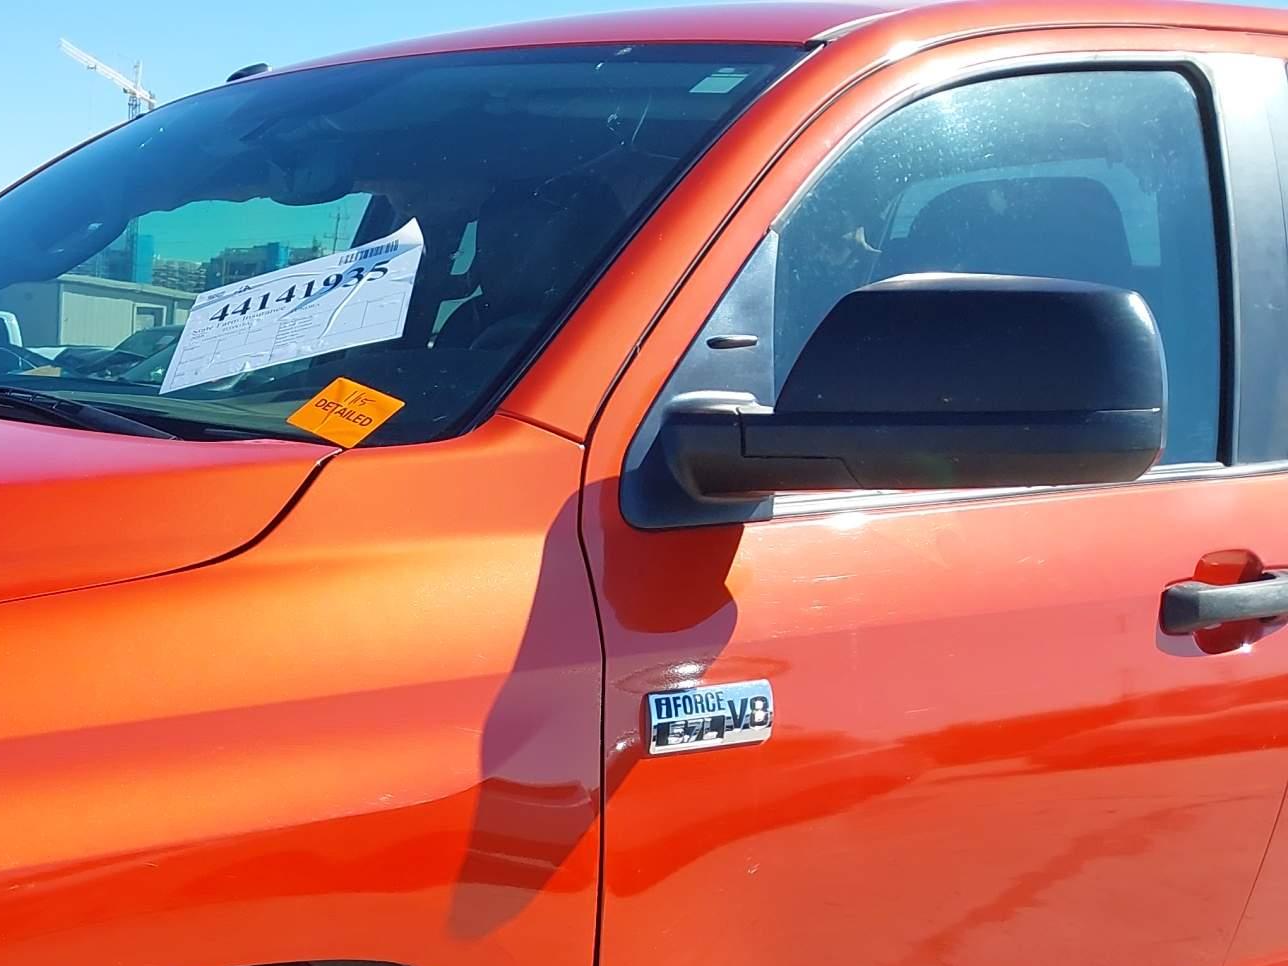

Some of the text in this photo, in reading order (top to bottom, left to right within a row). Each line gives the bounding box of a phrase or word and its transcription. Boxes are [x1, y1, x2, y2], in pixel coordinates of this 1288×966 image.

[209, 259, 392, 321] 44141935
[314, 398, 373, 427] DETAILED
[727, 695, 770, 731] V8
